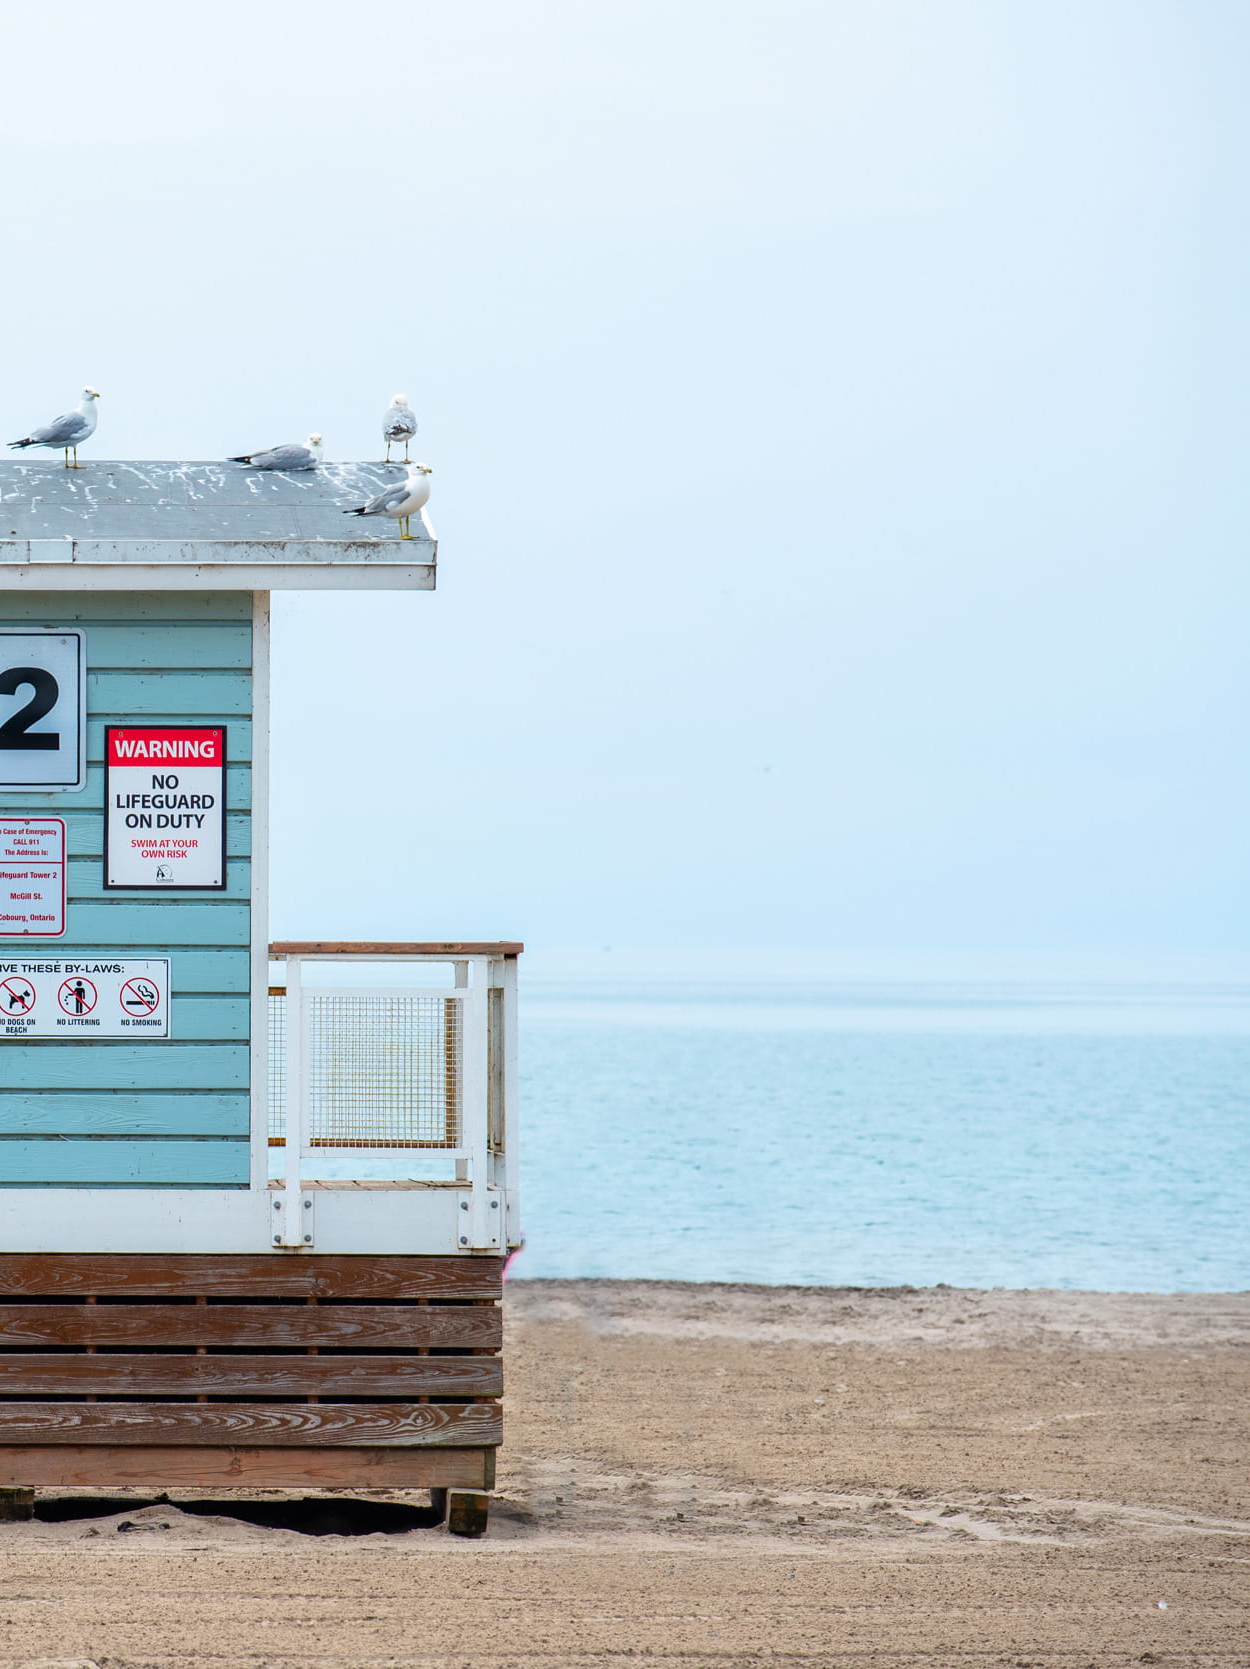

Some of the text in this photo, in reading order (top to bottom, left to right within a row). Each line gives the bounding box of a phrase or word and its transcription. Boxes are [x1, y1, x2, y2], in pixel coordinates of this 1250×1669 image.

[115, 740, 214, 758] WARNING
[152, 774, 179, 790] NO
[116, 794, 214, 809] LIFEGUARD
[125, 814, 205, 828] ON DUTY
[131, 840, 156, 848] SWIM
[172, 840, 198, 848] YOUR
[141, 850, 188, 858] OWN RISK
[21, 964, 61, 973] THESE
[65, 964, 124, 974] BY-LAWS:
